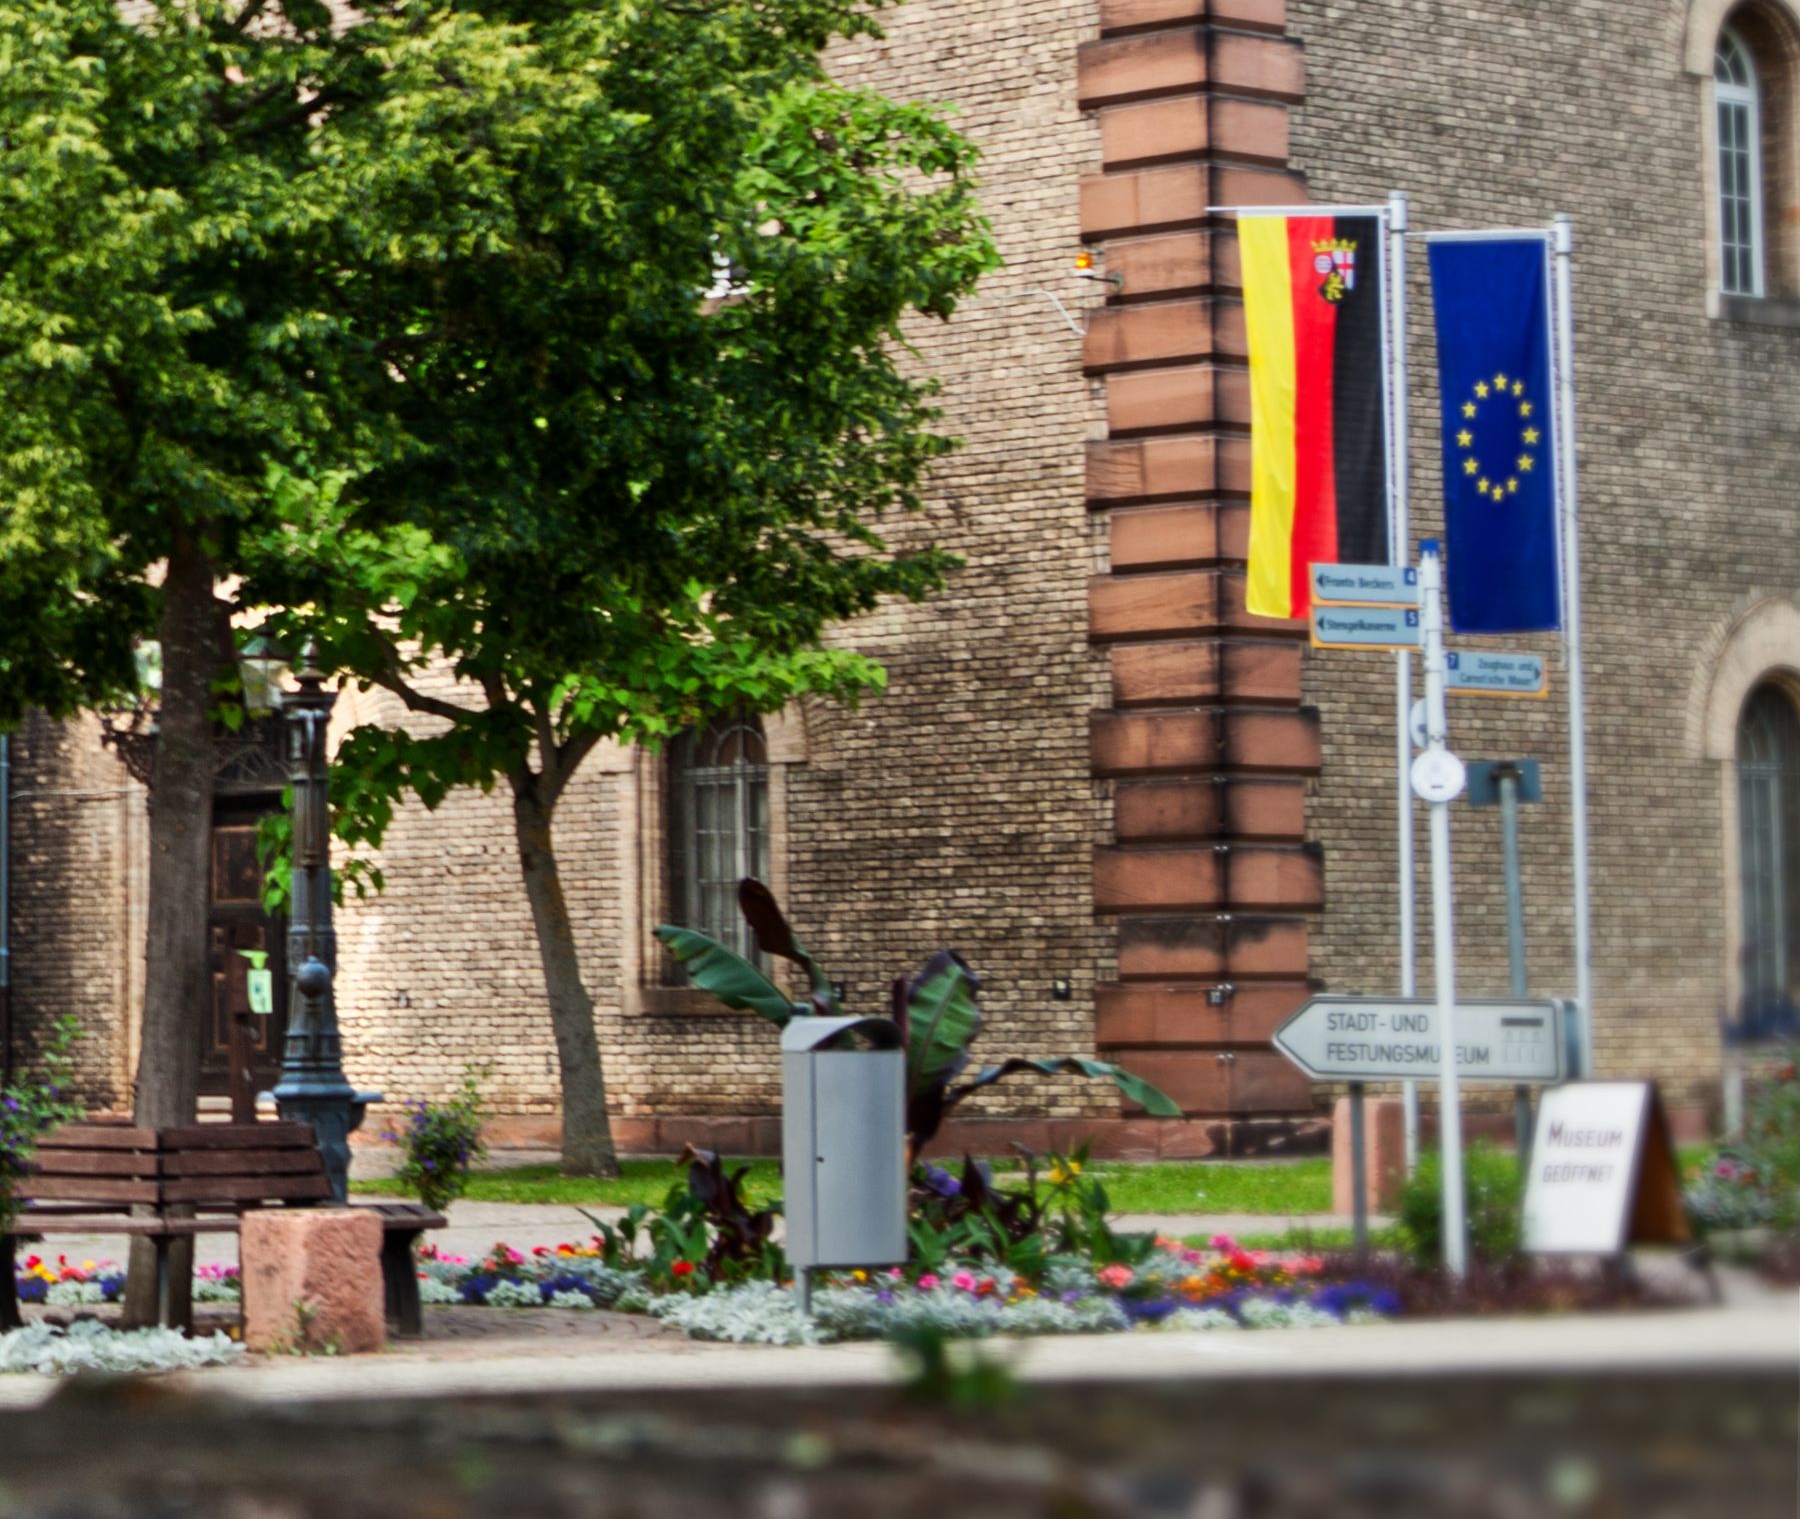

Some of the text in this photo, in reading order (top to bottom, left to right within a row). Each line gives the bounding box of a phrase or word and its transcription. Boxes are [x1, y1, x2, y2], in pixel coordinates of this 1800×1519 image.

[1326, 1012, 1429, 1032] STADT- UND
[1326, 1042, 1490, 1065] FESTUNGSMUEUM
